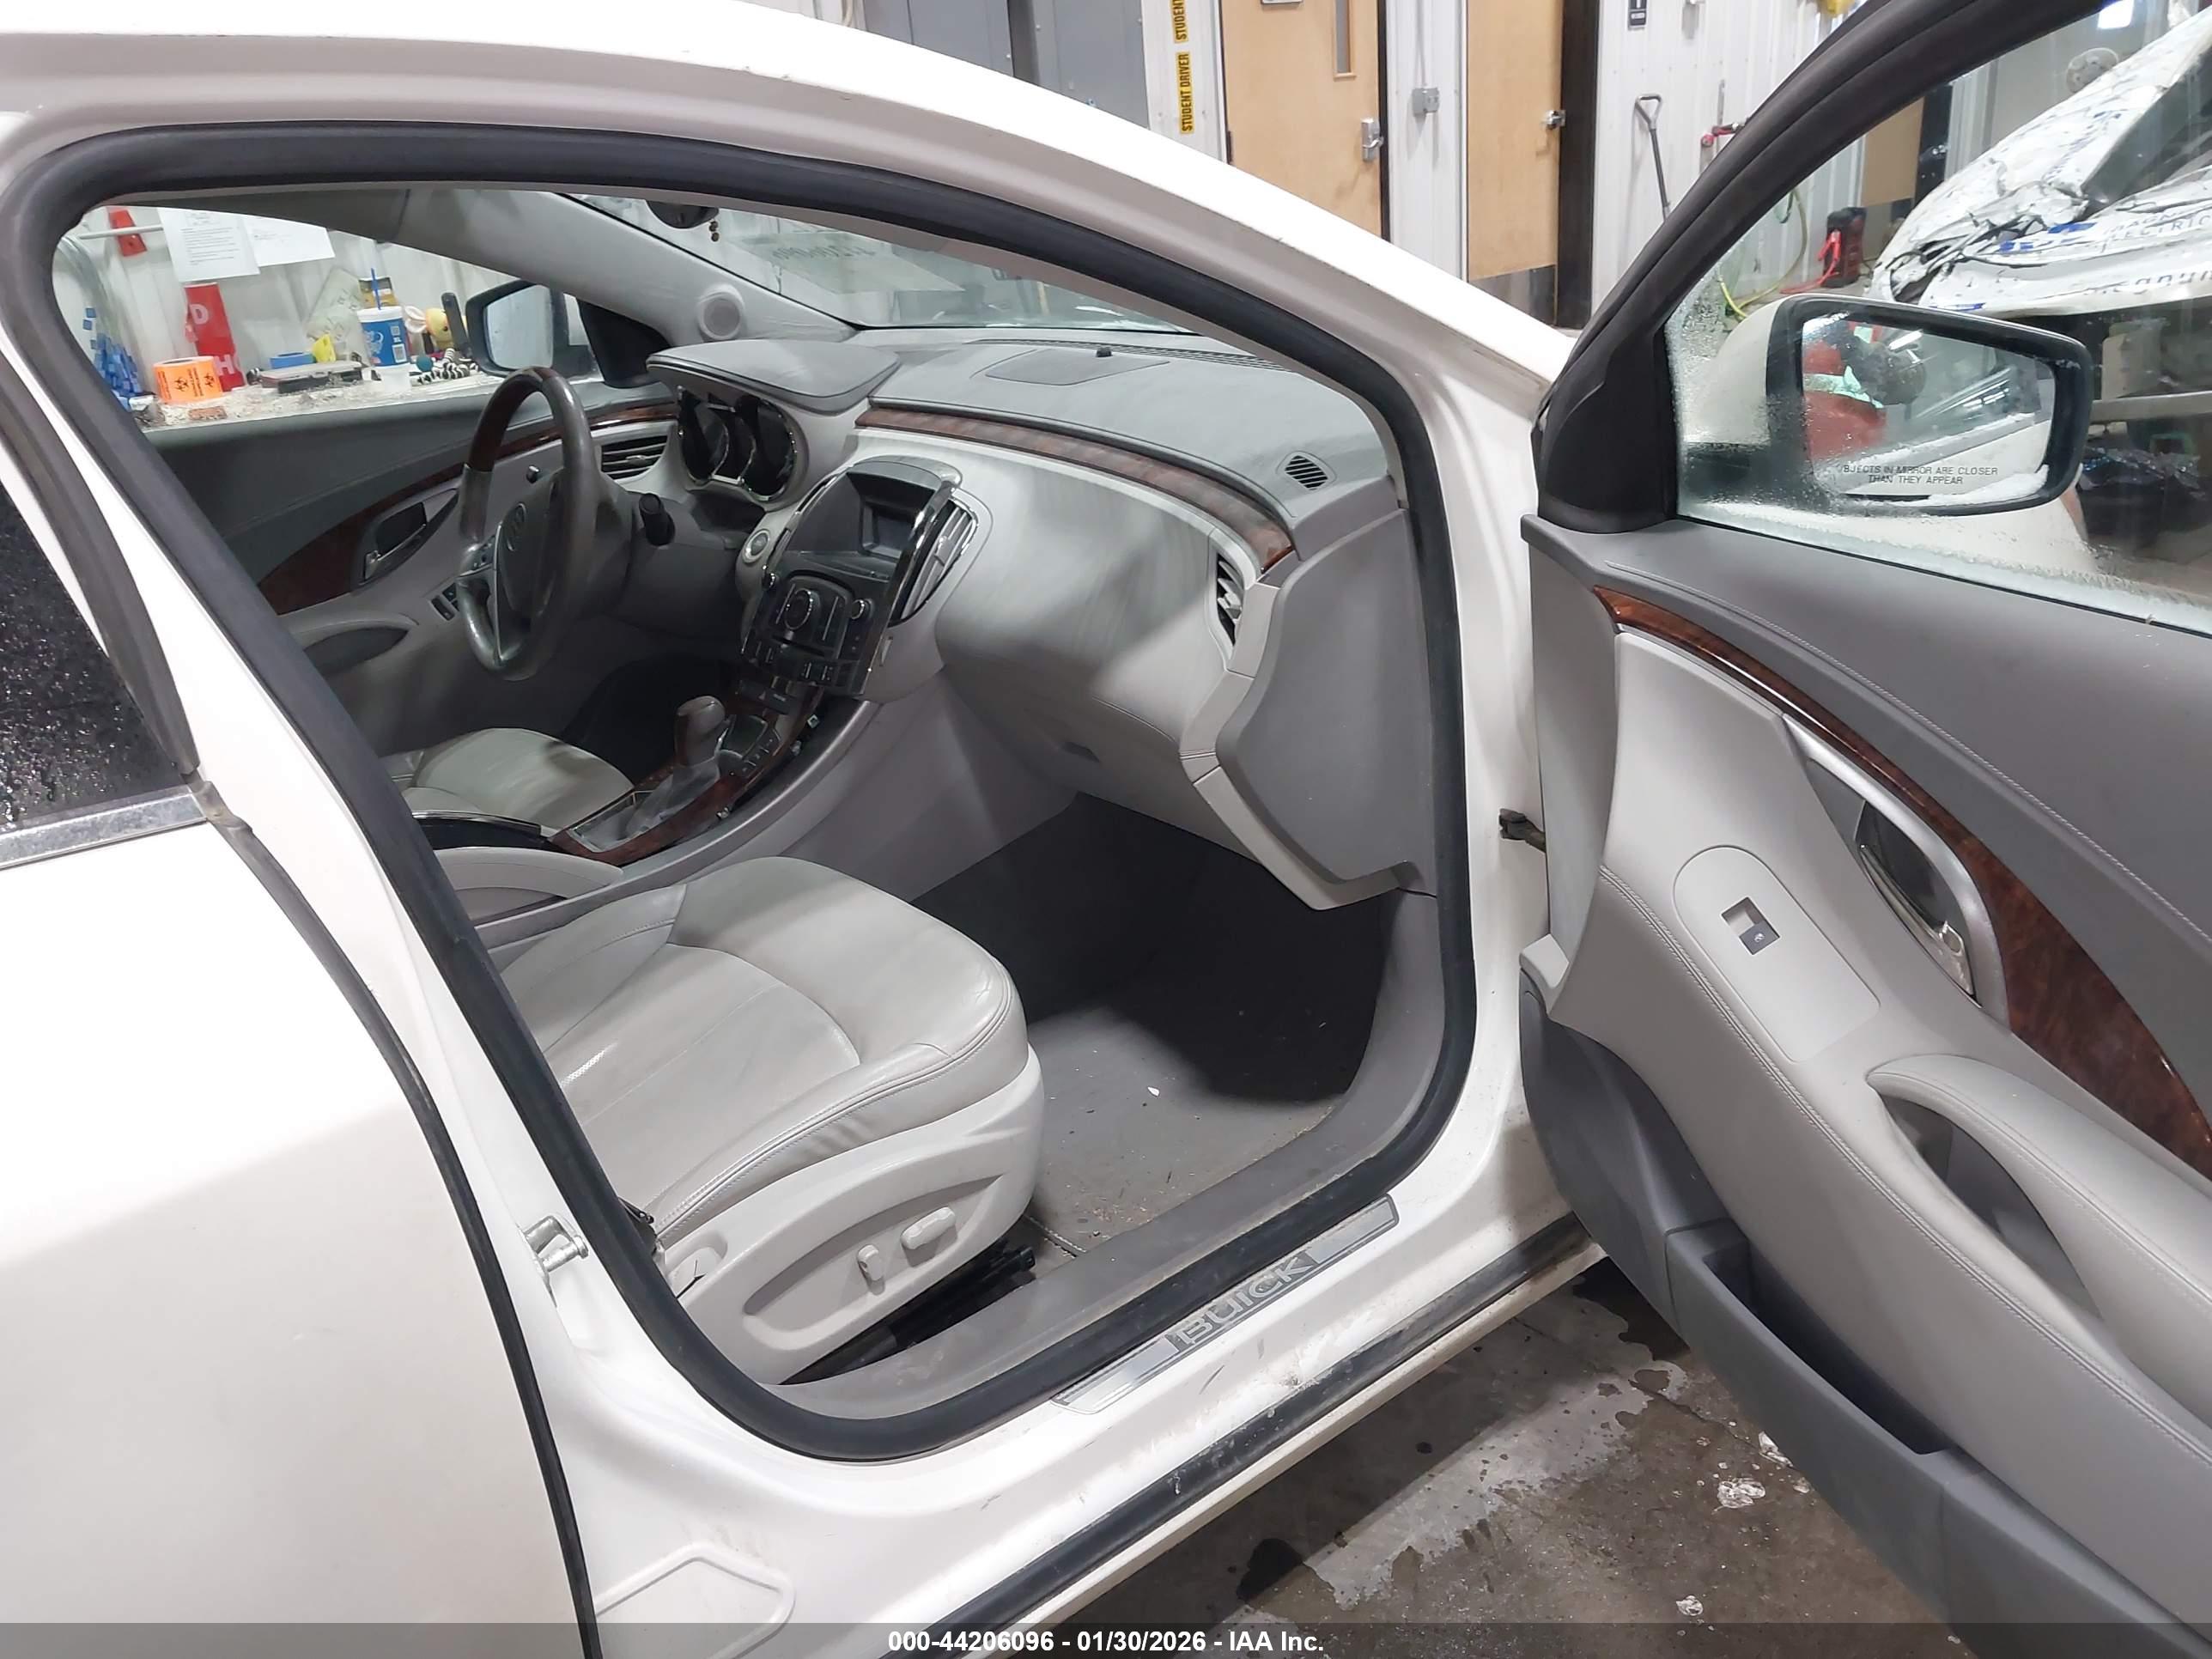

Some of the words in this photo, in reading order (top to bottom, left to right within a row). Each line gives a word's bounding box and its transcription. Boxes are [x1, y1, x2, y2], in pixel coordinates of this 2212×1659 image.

[1178, 53, 1191, 88] DRIVER
[1180, 90, 1193, 131] STUDENT
[214, 354, 238, 375] H
[1842, 465, 1881, 473] BJECTS
[1936, 466, 1955, 475] ARE
[1958, 466, 1998, 476] CLOSER
[1869, 474, 1893, 483] THAN
[1899, 475, 1923, 483] THEY
[1926, 476, 1964, 485] APPEAR
[1176, 1256, 1313, 1345] BUICK
